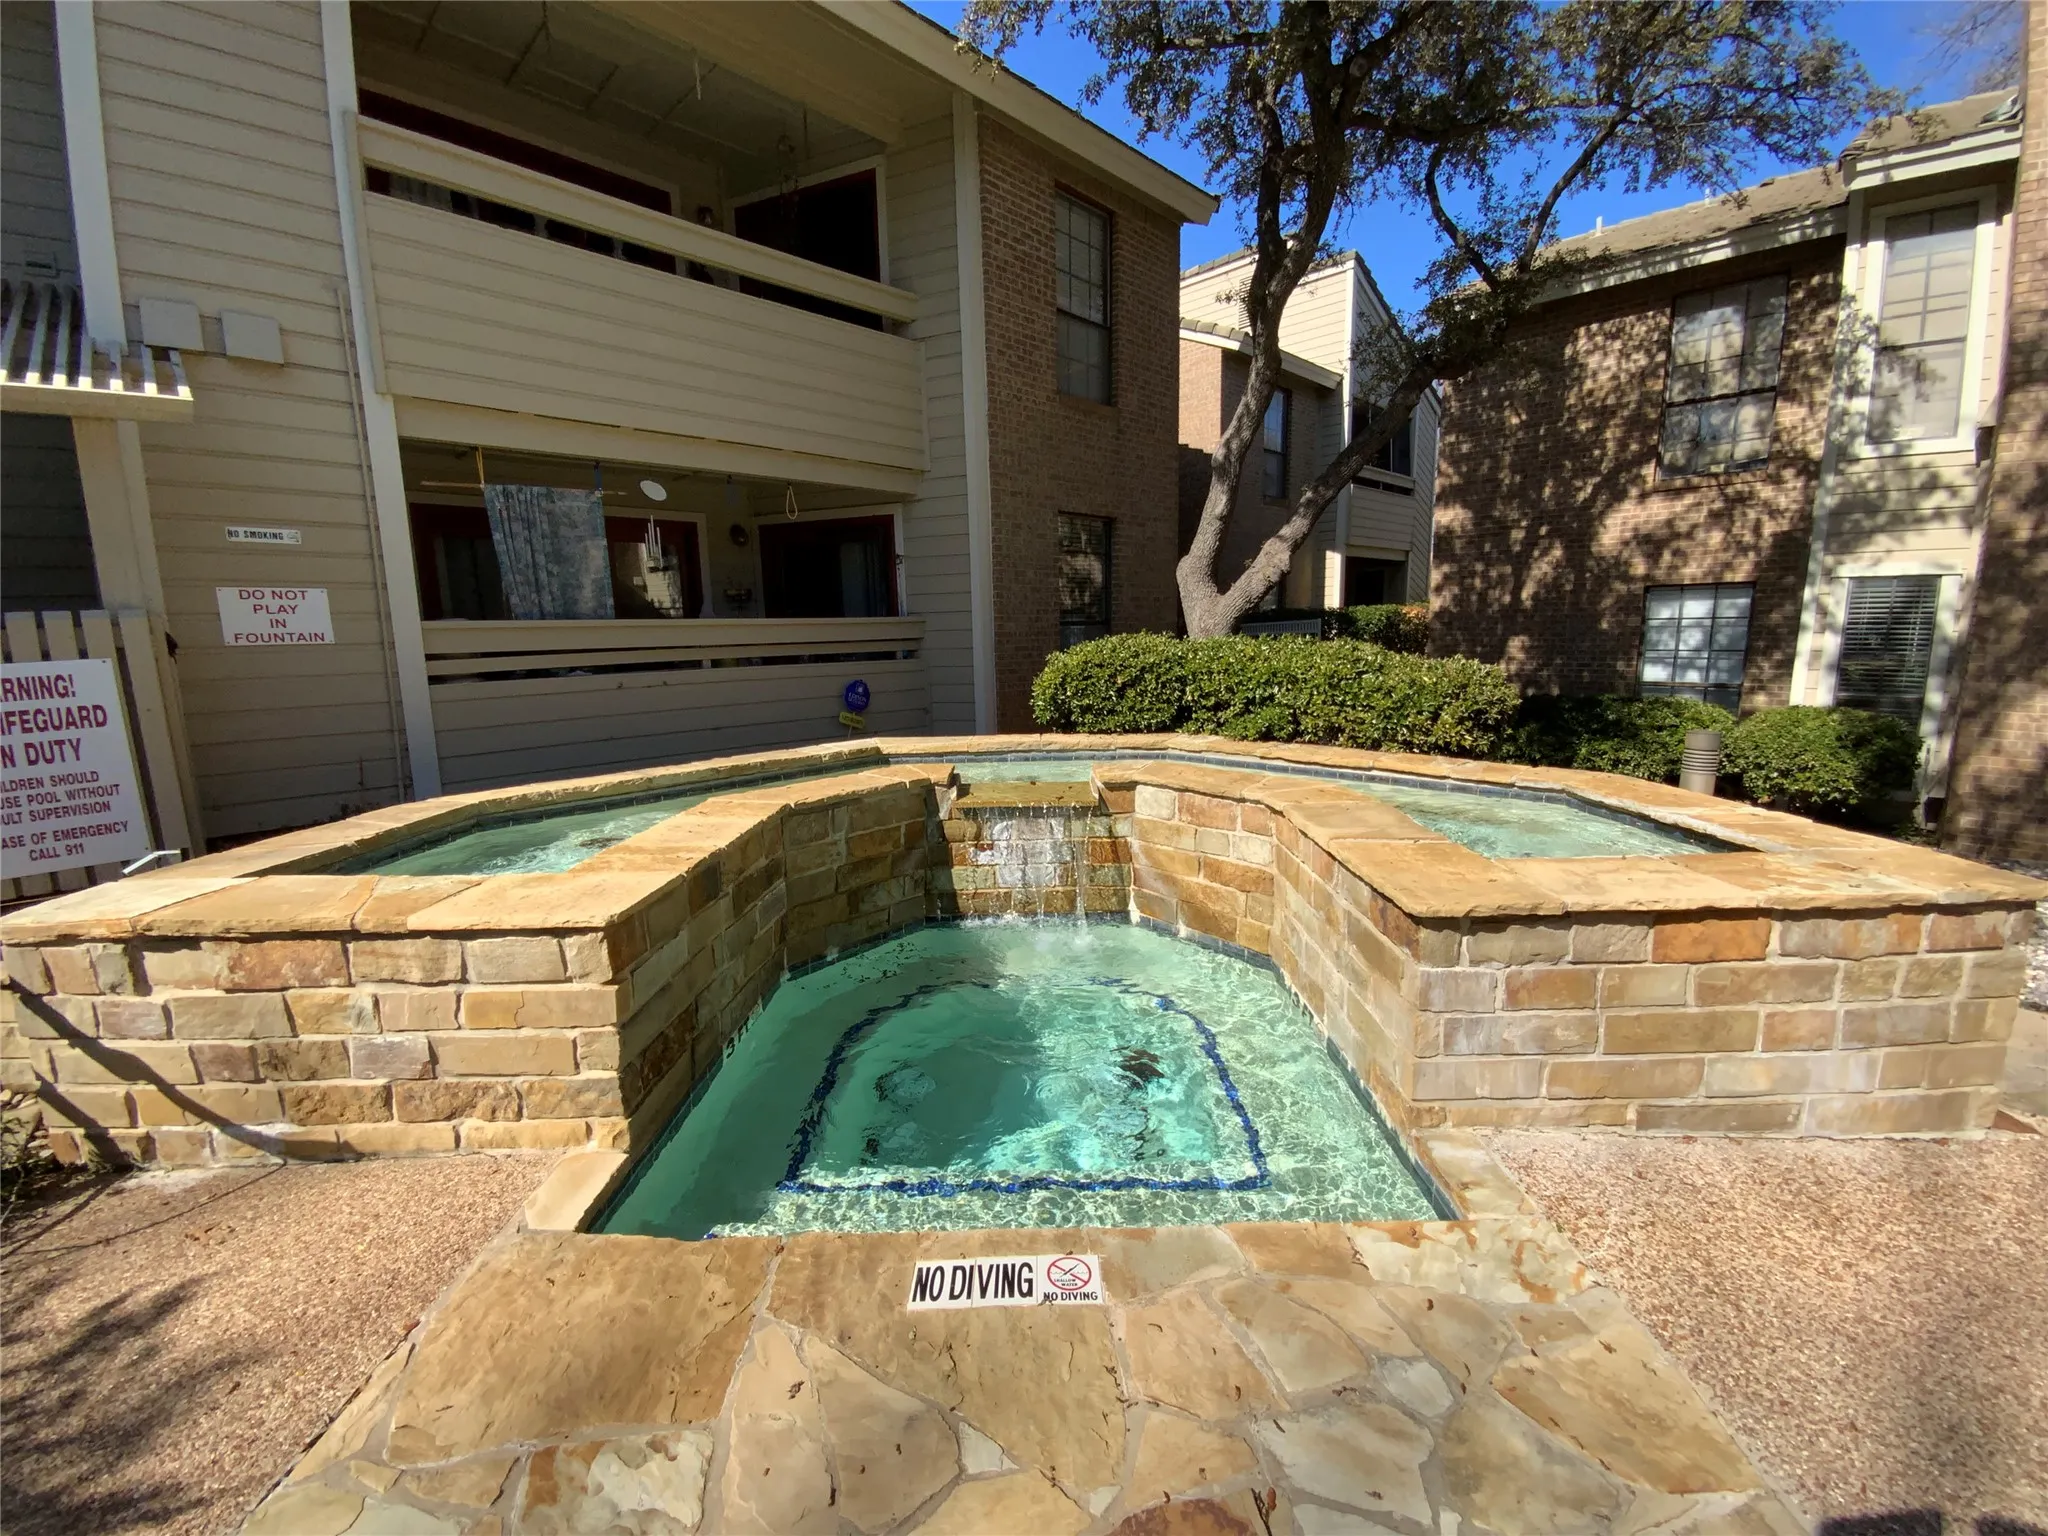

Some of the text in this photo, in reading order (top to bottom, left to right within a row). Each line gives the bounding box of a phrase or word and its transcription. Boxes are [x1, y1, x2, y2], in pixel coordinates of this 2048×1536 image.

[227, 529, 284, 541] NO SMOKING
[239, 590, 308, 600] DO NOT
[253, 604, 298, 615] PLAY
[270, 618, 287, 629] IN
[234, 633, 325, 643] FOUNTAIN
[0, 674, 76, 702] RNING!
[0, 704, 108, 736] IFEGUARD
[0, 738, 82, 769] N DUTY
[0, 771, 100, 794] ILDREN SHOULD
[26, 792, 61, 806] POOL
[65, 784, 120, 801] WITHOUT
[1, 801, 112, 826] ULT SUPERVISION
[1, 820, 129, 850] ASE OF EMERGENCY
[29, 842, 85, 861] CALL 911
[725, 1036, 736, 1060] 3
[912, 1262, 1034, 1302] NO DIVING
[1043, 1291, 1099, 1301] NO DIVING
